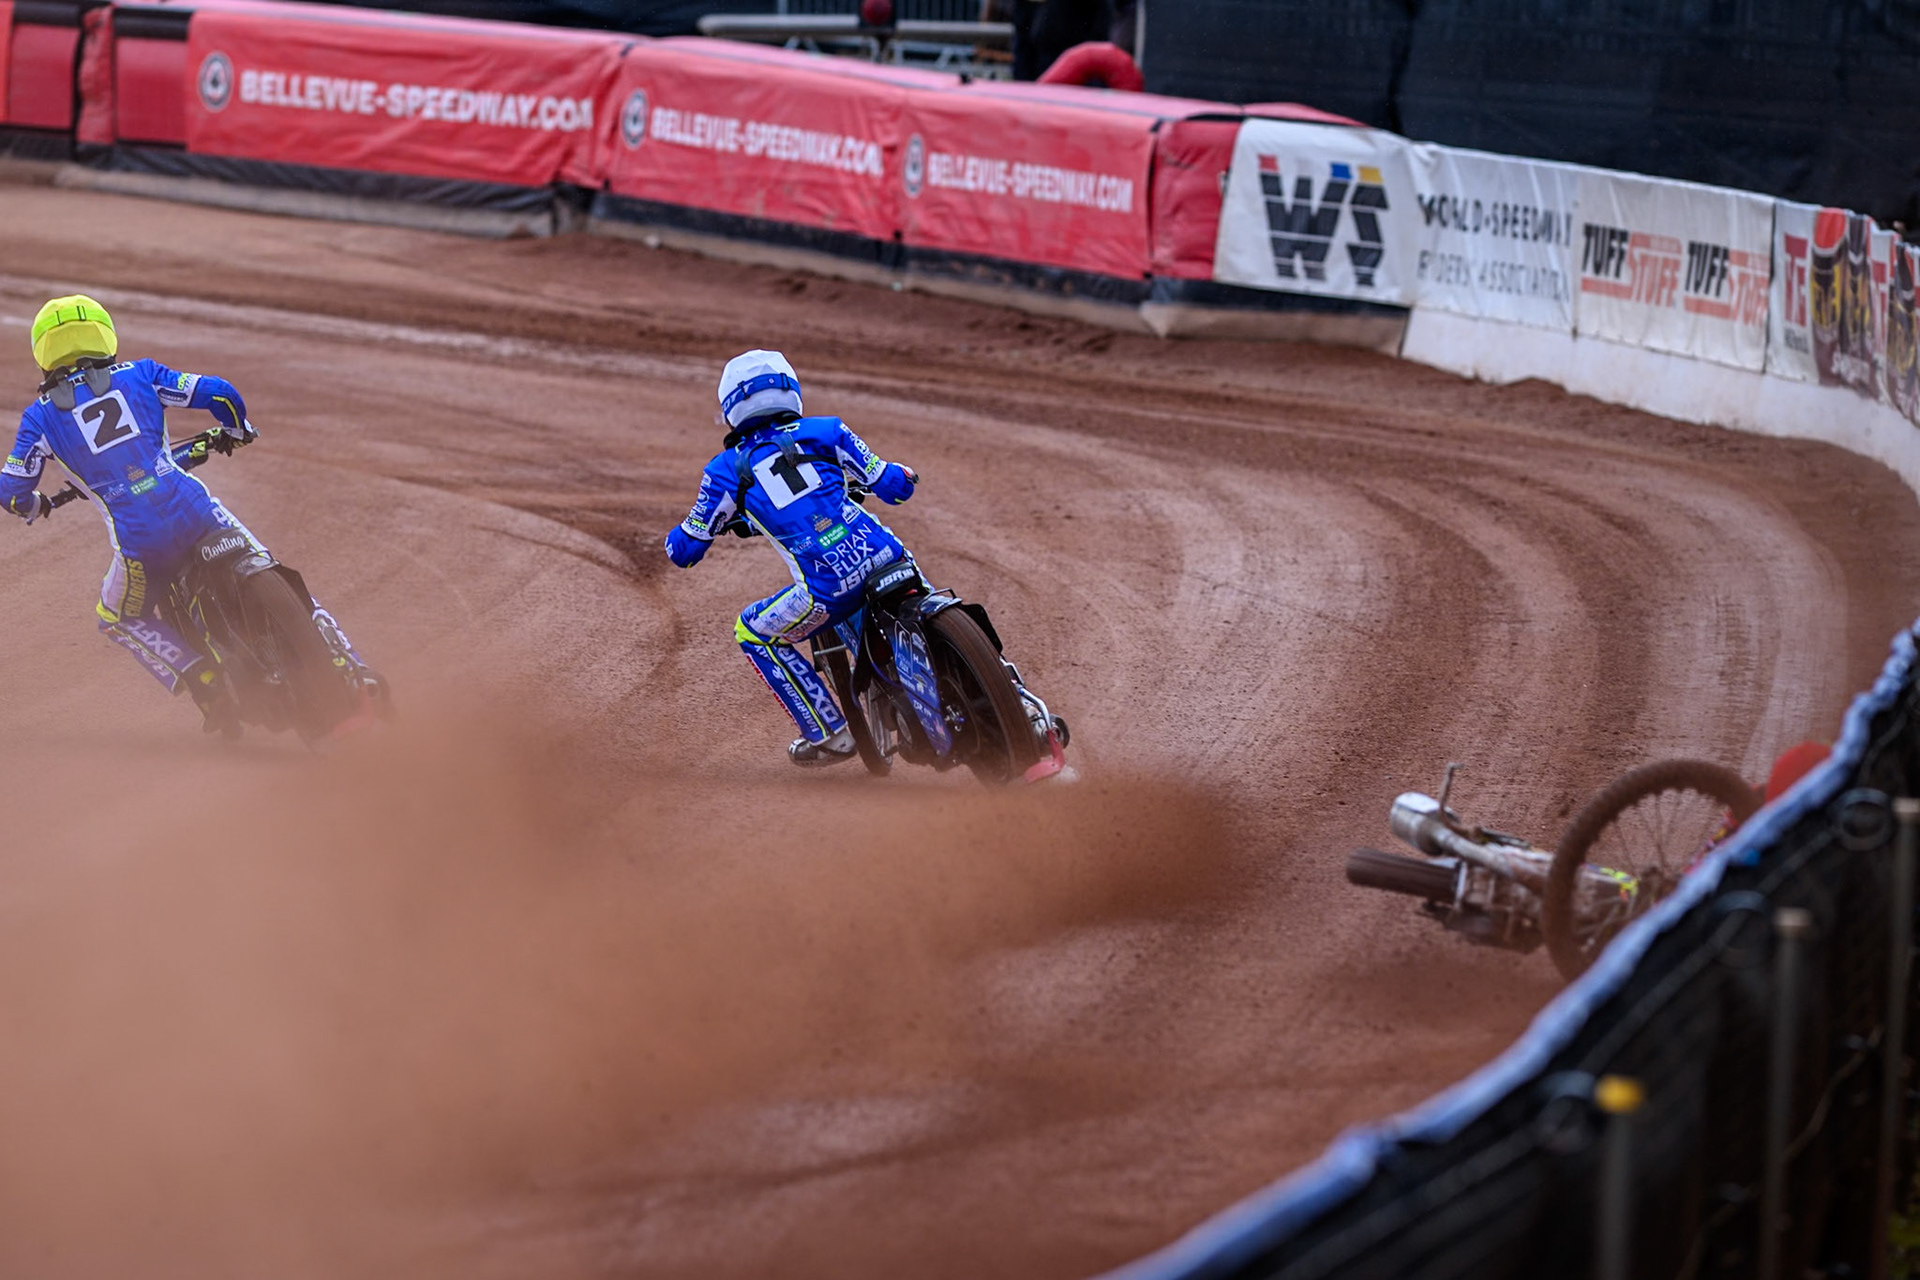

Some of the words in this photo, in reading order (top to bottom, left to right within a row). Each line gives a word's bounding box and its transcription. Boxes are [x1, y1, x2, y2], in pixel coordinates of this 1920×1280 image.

[927, 151, 1134, 214] BELLEVUE-SPEEDWAY.COM
[1582, 222, 1629, 279] TUFF
[1685, 240, 1730, 298] TUFF
[81, 397, 133, 449] 2
[769, 454, 809, 496] 1
[201, 535, 245, 562] Clouting
[814, 523, 873, 573] ADRIAN
[831, 541, 874, 578] FLUX
[124, 558, 147, 617] CHARGERS
[832, 557, 874, 598] JSR
[875, 569, 904, 592] JSR
[753, 644, 772, 661] ILY
[774, 645, 840, 724] OXFOR
[782, 682, 821, 733] HARRISON
